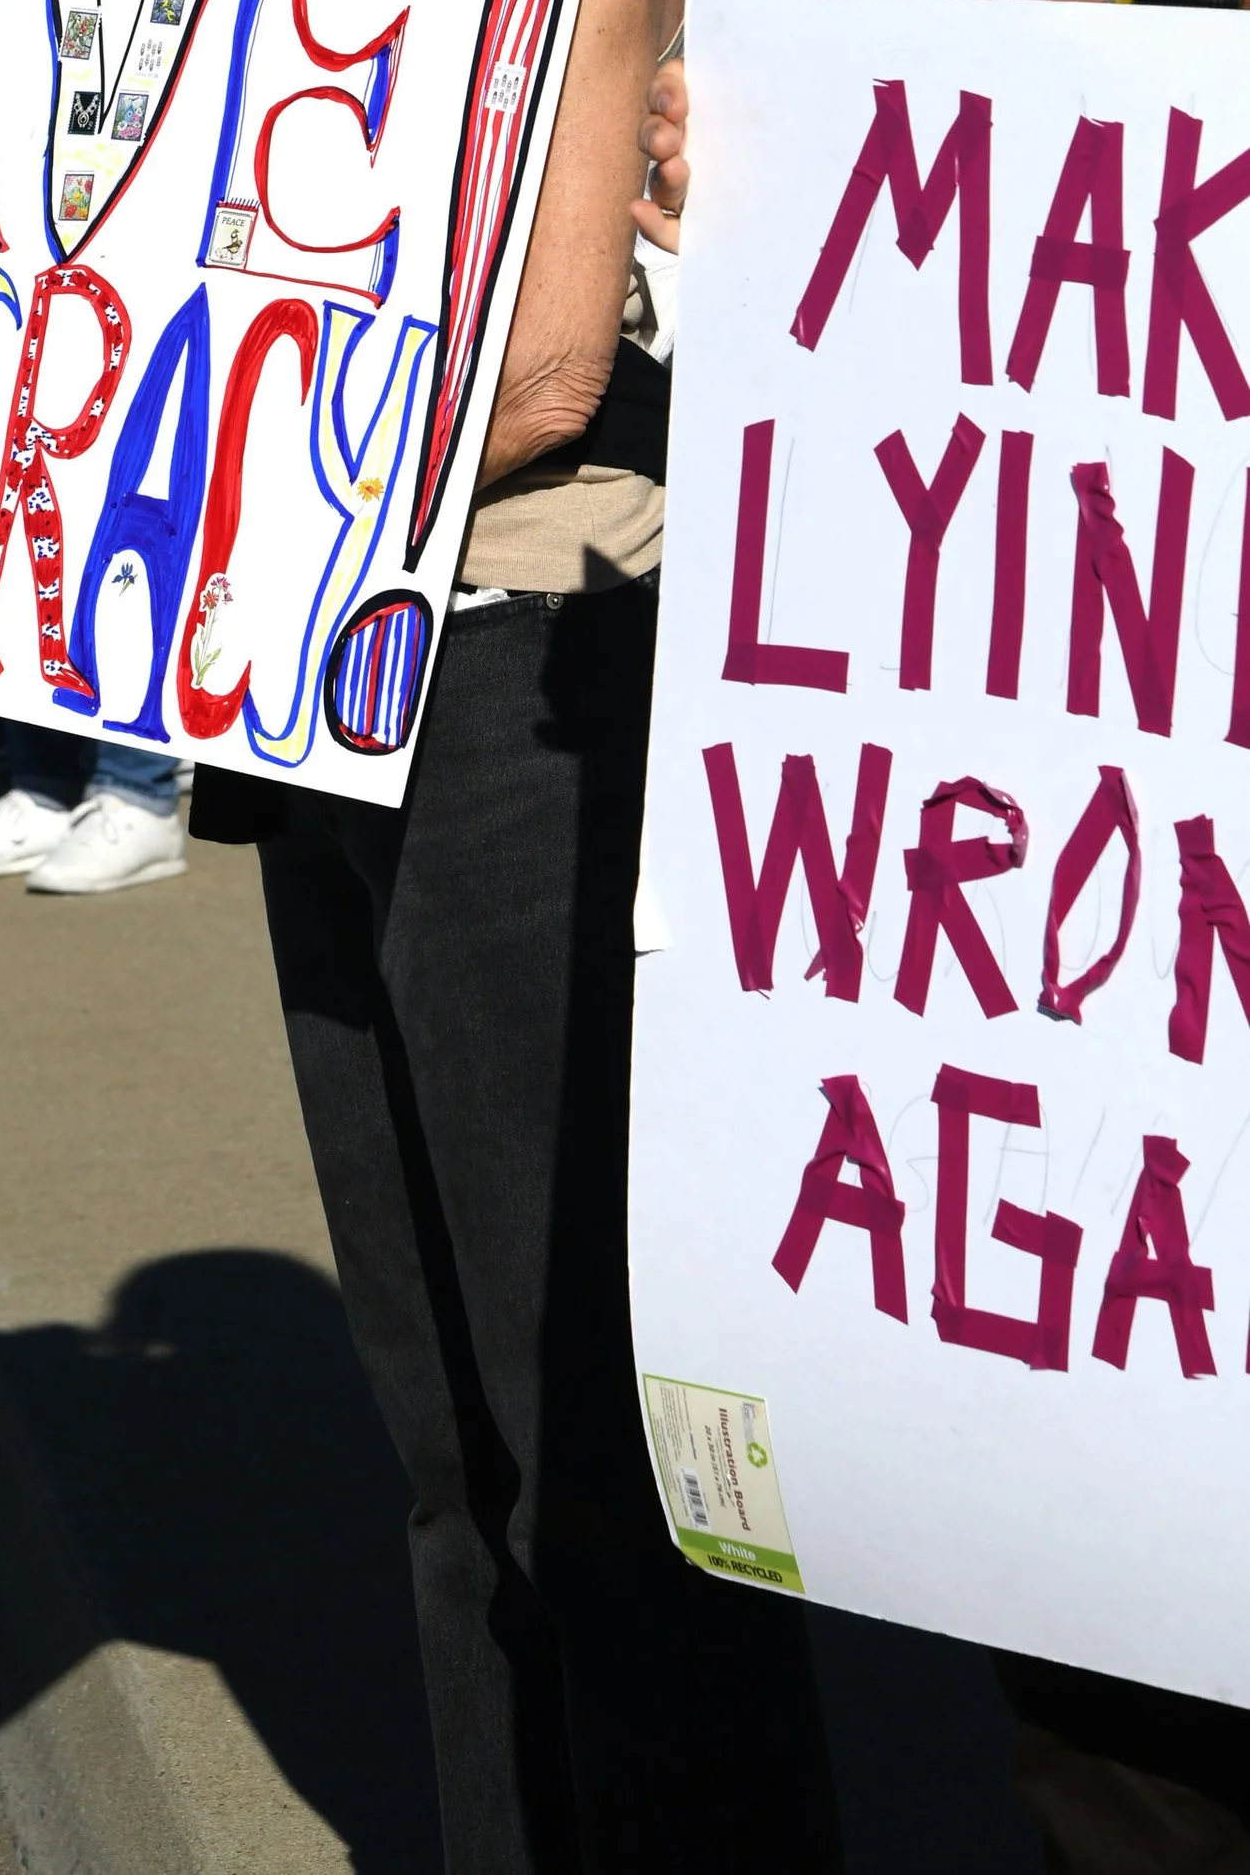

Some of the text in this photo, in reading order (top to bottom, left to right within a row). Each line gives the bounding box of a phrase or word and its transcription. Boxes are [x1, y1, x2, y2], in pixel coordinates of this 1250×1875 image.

[221, 216, 246, 227] PEACE
[788, 78, 1250, 422] MAK
[720, 411, 1250, 751] LYIN
[770, 1063, 1250, 1380] AGA
[718, 1407, 751, 1531] Illustration Board
[707, 1553, 783, 1584] 100% RECYCLED
[717, 1540, 757, 1562] White
